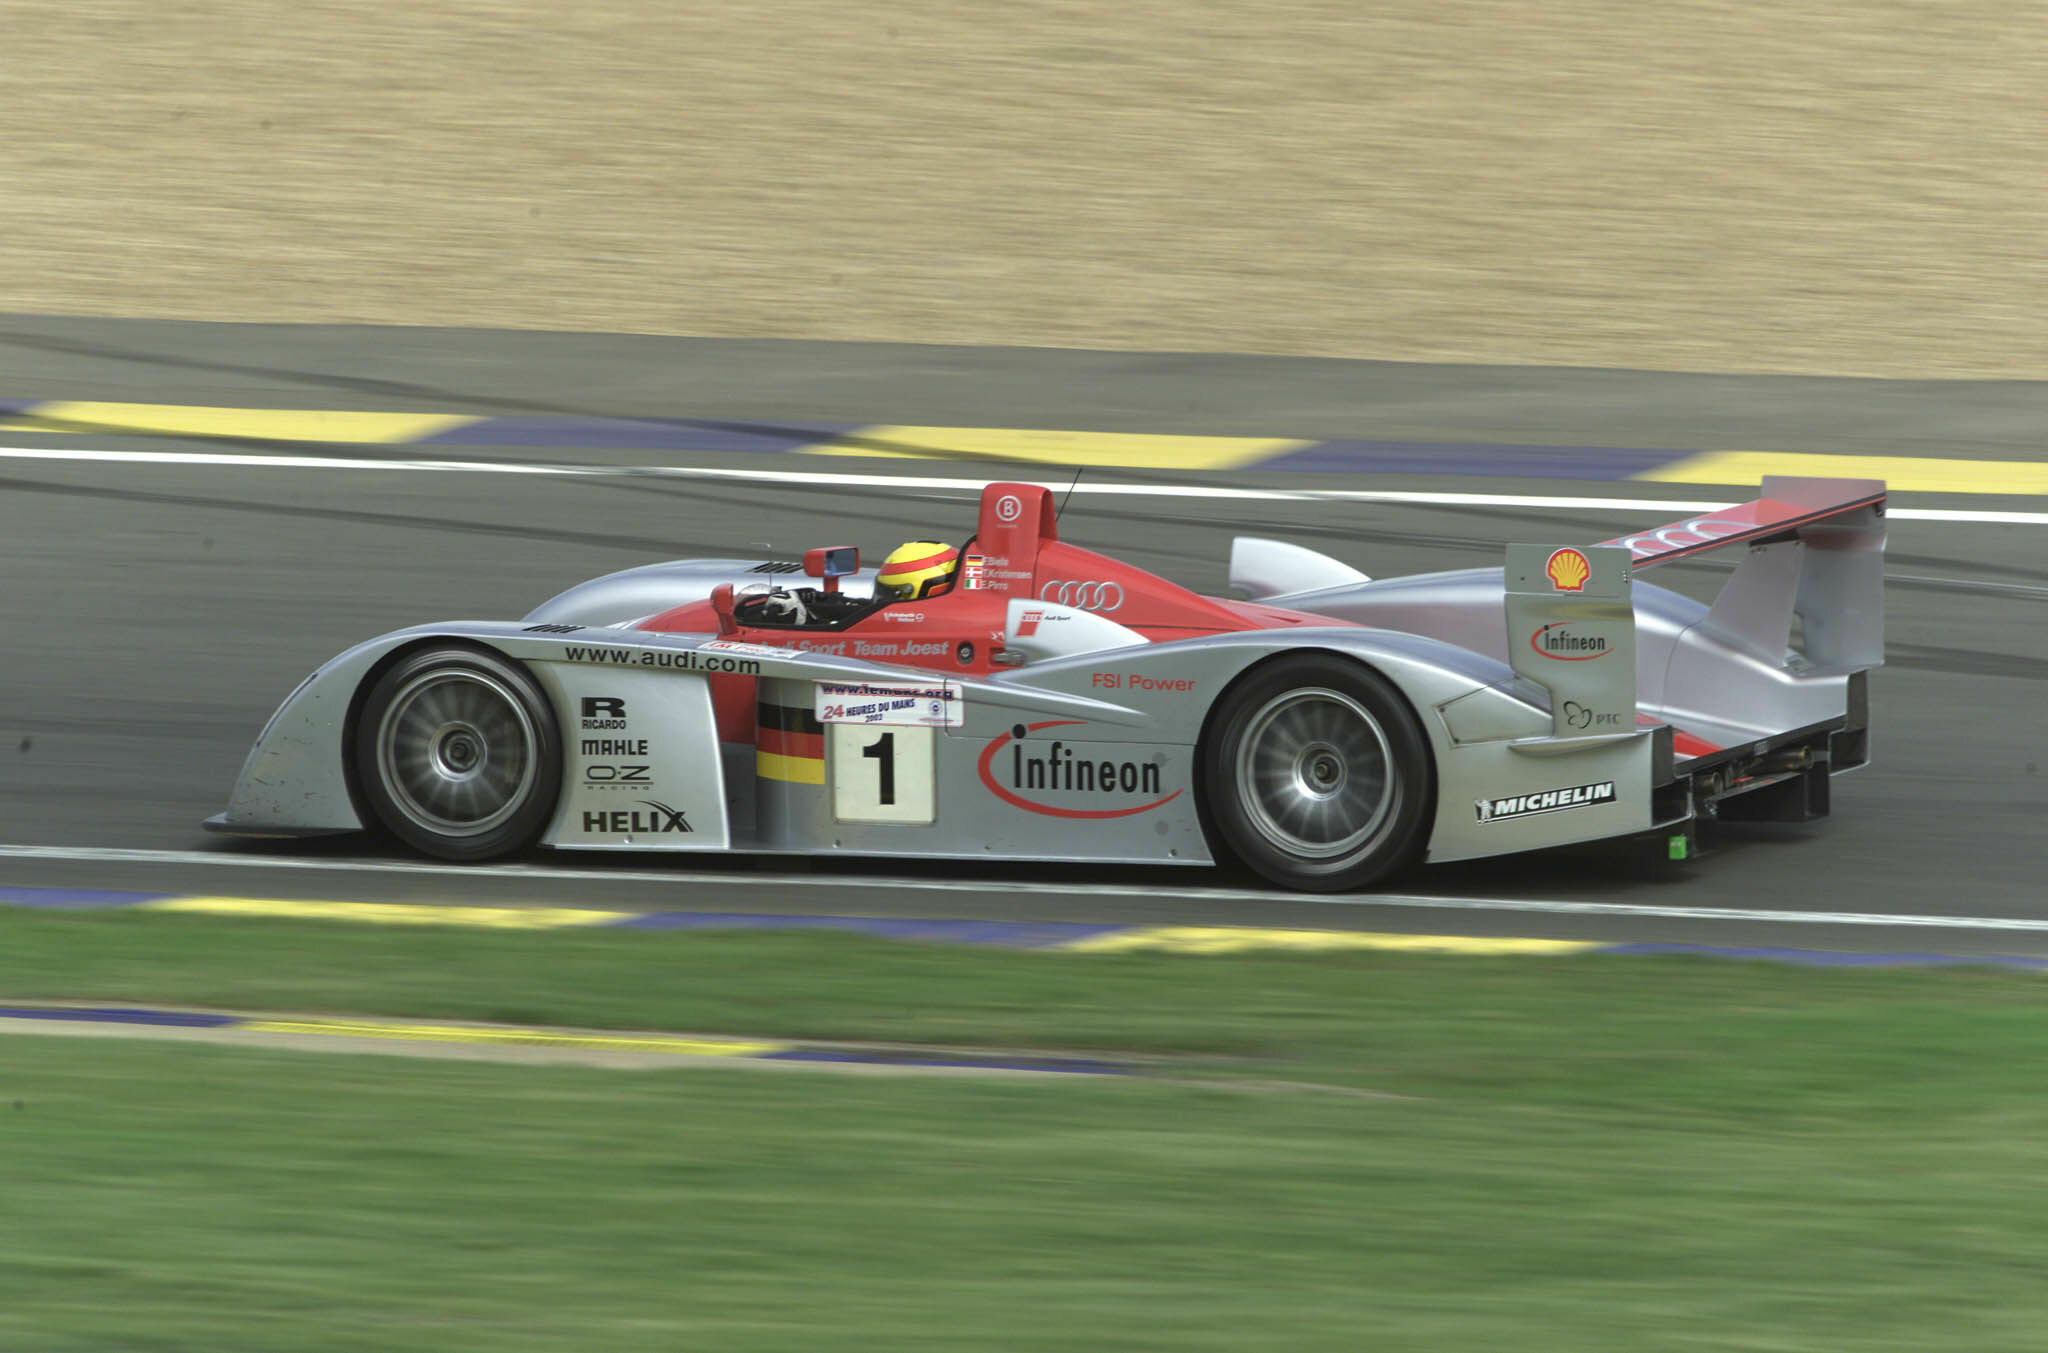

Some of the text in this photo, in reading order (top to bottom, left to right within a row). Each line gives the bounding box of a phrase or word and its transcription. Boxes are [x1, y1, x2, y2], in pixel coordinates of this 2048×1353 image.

[853, 641, 896, 656] Team
[900, 640, 949, 656] Joest
[565, 647, 761, 674] www.audi.com
[1092, 673, 1196, 692] FSI Power
[823, 699, 915, 720] 24 HEURES DU MANS
[1596, 714, 1621, 725] PTC
[582, 719, 626, 730] RICARDO
[582, 740, 648, 756] MAHLE
[862, 732, 895, 805] 1
[1494, 782, 1613, 816] MICHELIN
[583, 811, 694, 833] HELIX
